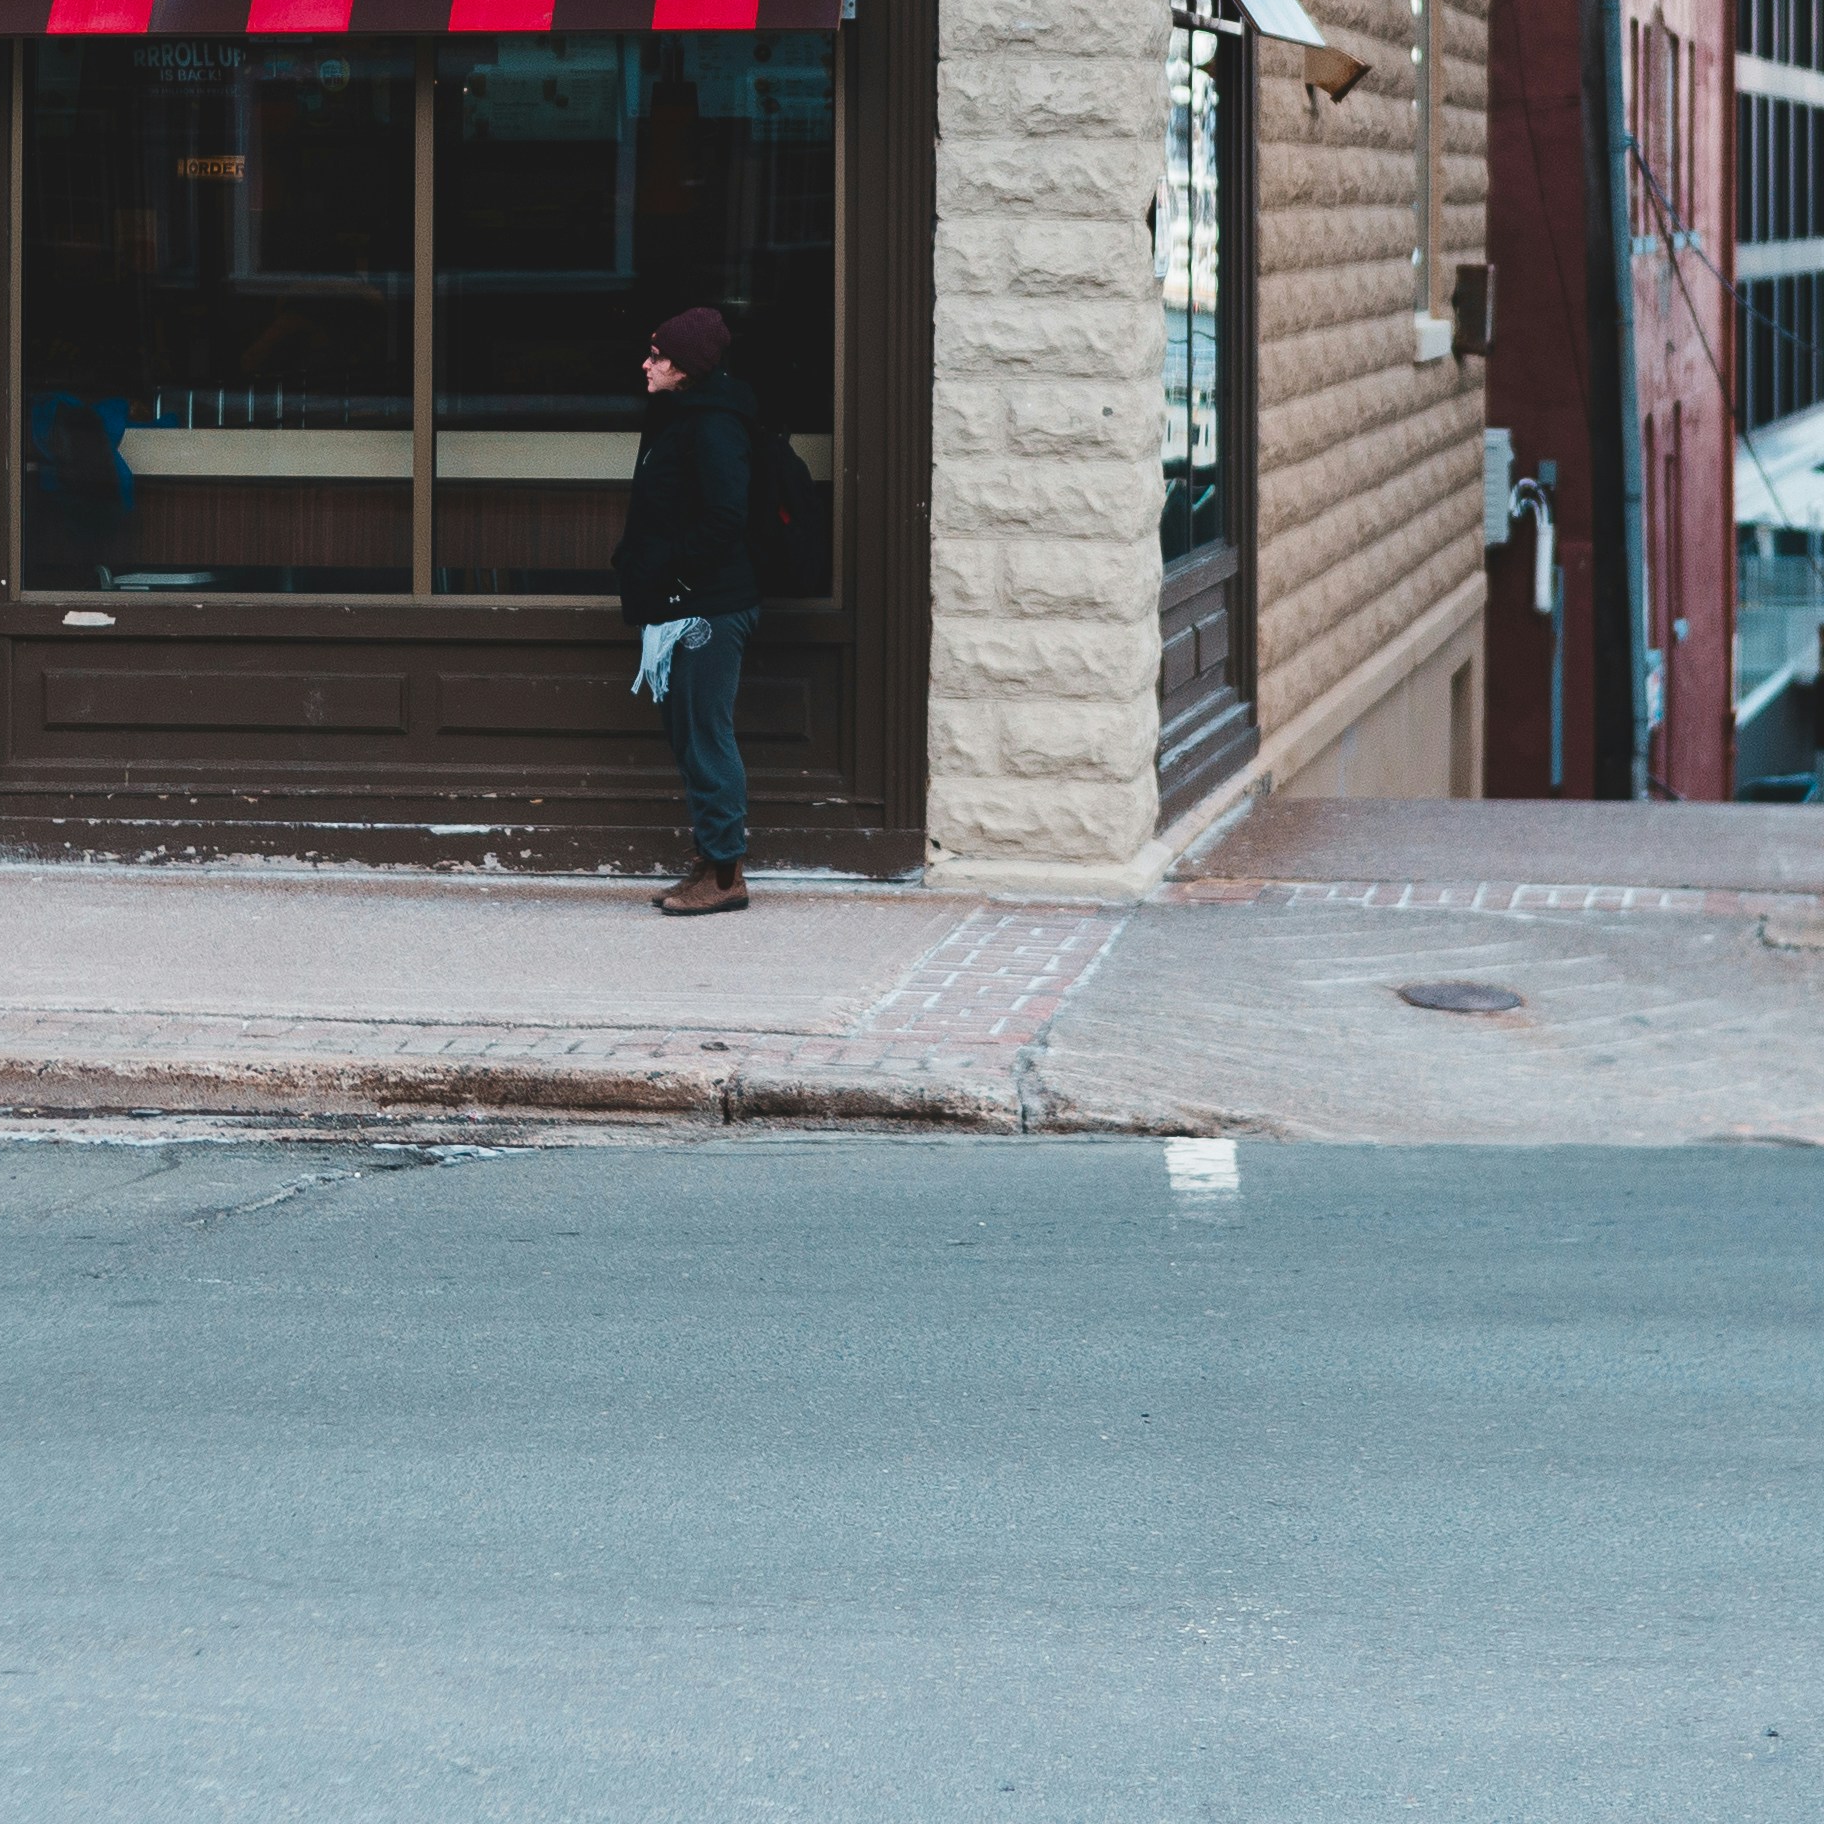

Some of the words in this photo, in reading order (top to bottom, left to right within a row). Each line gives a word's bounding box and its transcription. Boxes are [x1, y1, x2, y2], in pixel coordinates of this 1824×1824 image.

[133, 41, 215, 68] RRROLL
[159, 69, 174, 82] IS
[177, 68, 222, 82] BACK!
